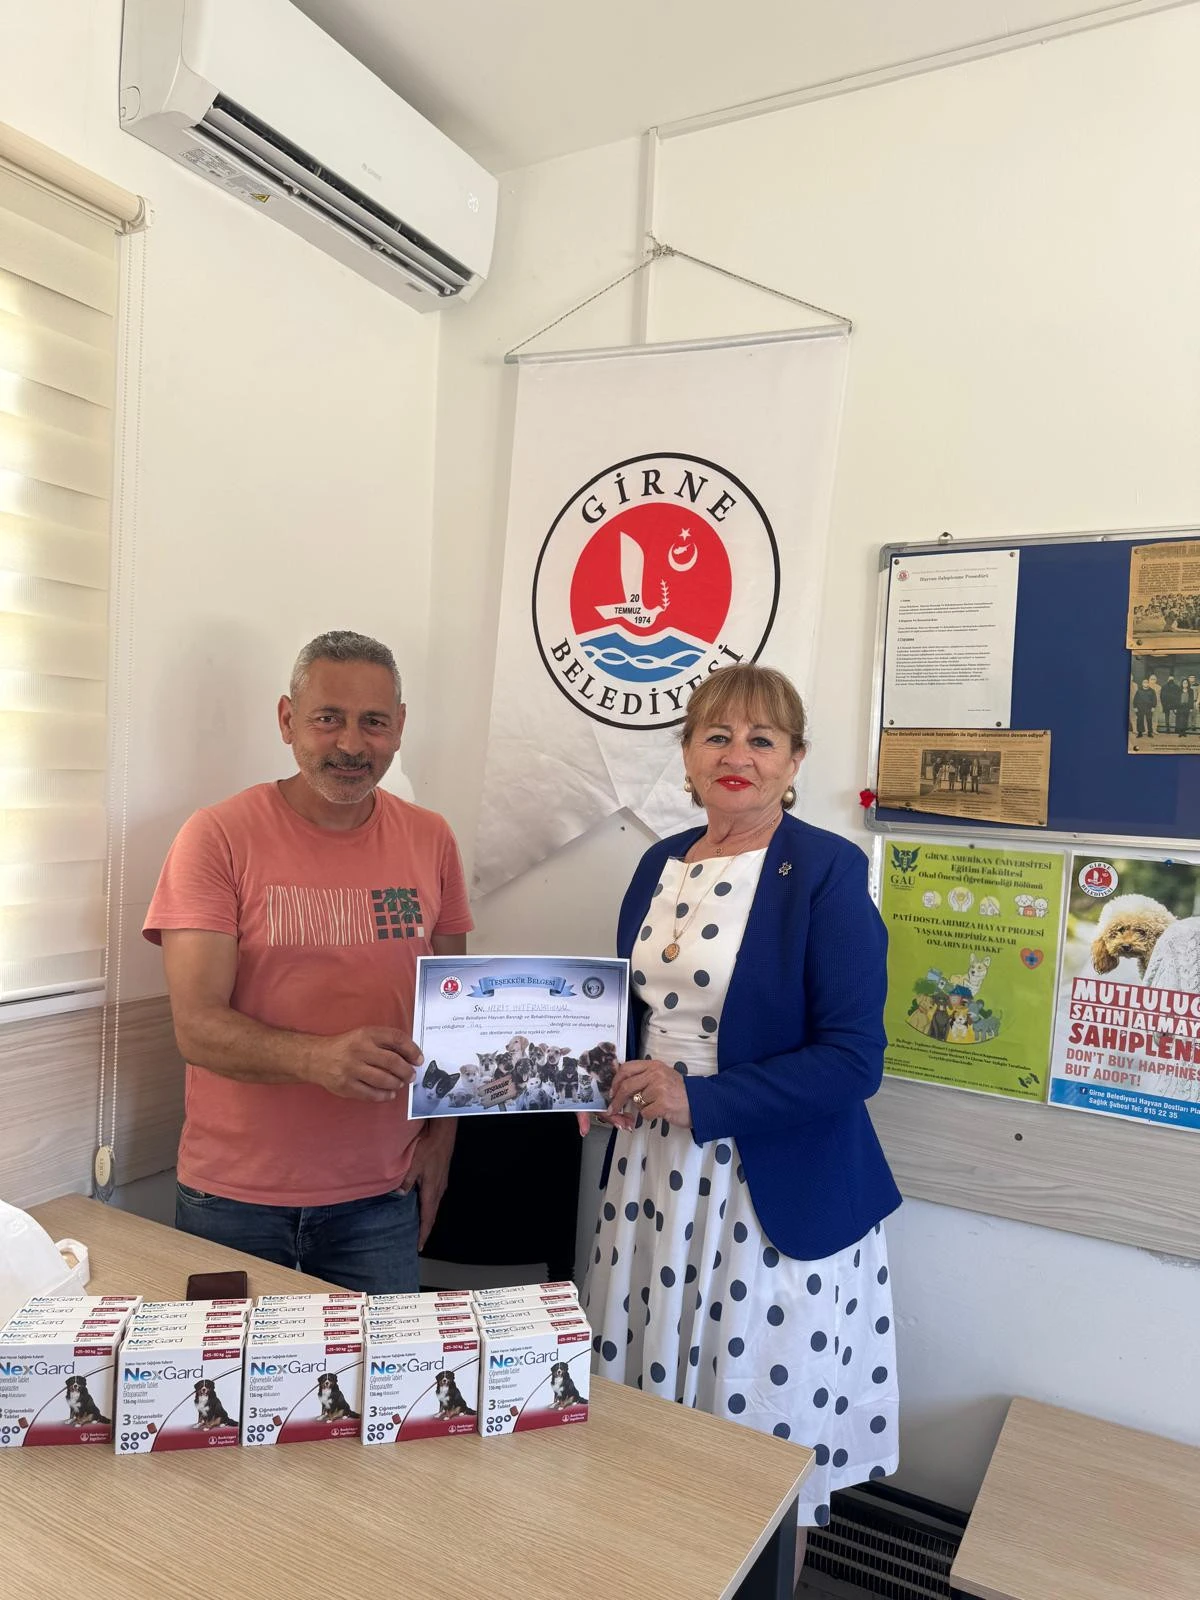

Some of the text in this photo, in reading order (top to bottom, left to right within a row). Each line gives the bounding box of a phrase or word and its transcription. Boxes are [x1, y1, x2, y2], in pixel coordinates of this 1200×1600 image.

[581, 469, 736, 523] GİRNE
[630, 594, 640, 603] 20
[614, 607, 641, 615] TEMMUZ
[634, 616, 651, 624] 1974
[925, 853, 1052, 870] GİRNE AMERİKAN ÜNİVERSİTESİ
[918, 871, 936, 879] Okul
[937, 872, 962, 882] Öncesi
[951, 864, 1023, 878] Eğitim Fakültesi
[890, 874, 916, 886] GAU
[893, 913, 1044, 937] PATİ DOSTLARIMIZA HAYAT PROJESİ
[490, 977, 525, 986] TEŞEKKÜR
[1071, 1004, 1125, 1026] SATIN
[1108, 1055, 1134, 1069] BUY
[1065, 1062, 1141, 1086] BUT ADOPT!
[1089, 1089, 1105, 1098] Girne
[1106, 1092, 1138, 1104] Belediyesi
[1139, 1097, 1162, 1108] Hayvan
[1163, 1102, 1189, 1112] Dostları
[1089, 1097, 1108, 1107] Sağlık
[1109, 1100, 1130, 1110] Şubesi
[1131, 1104, 1143, 1113] Tel:
[1143, 1107, 1157, 1115] 815
[252, 1332, 305, 1340] NexGard
[369, 1331, 421, 1339] NexGard
[370, 1355, 445, 1376] NexGard
[489, 1348, 559, 1369] NexGard
[124, 1365, 204, 1382] NexGard
[250, 1358, 327, 1376] NexGard
[369, 1406, 377, 1417] 3
[488, 1399, 496, 1410] 3
[249, 1407, 258, 1418] 3
[122, 1414, 131, 1426] 3
